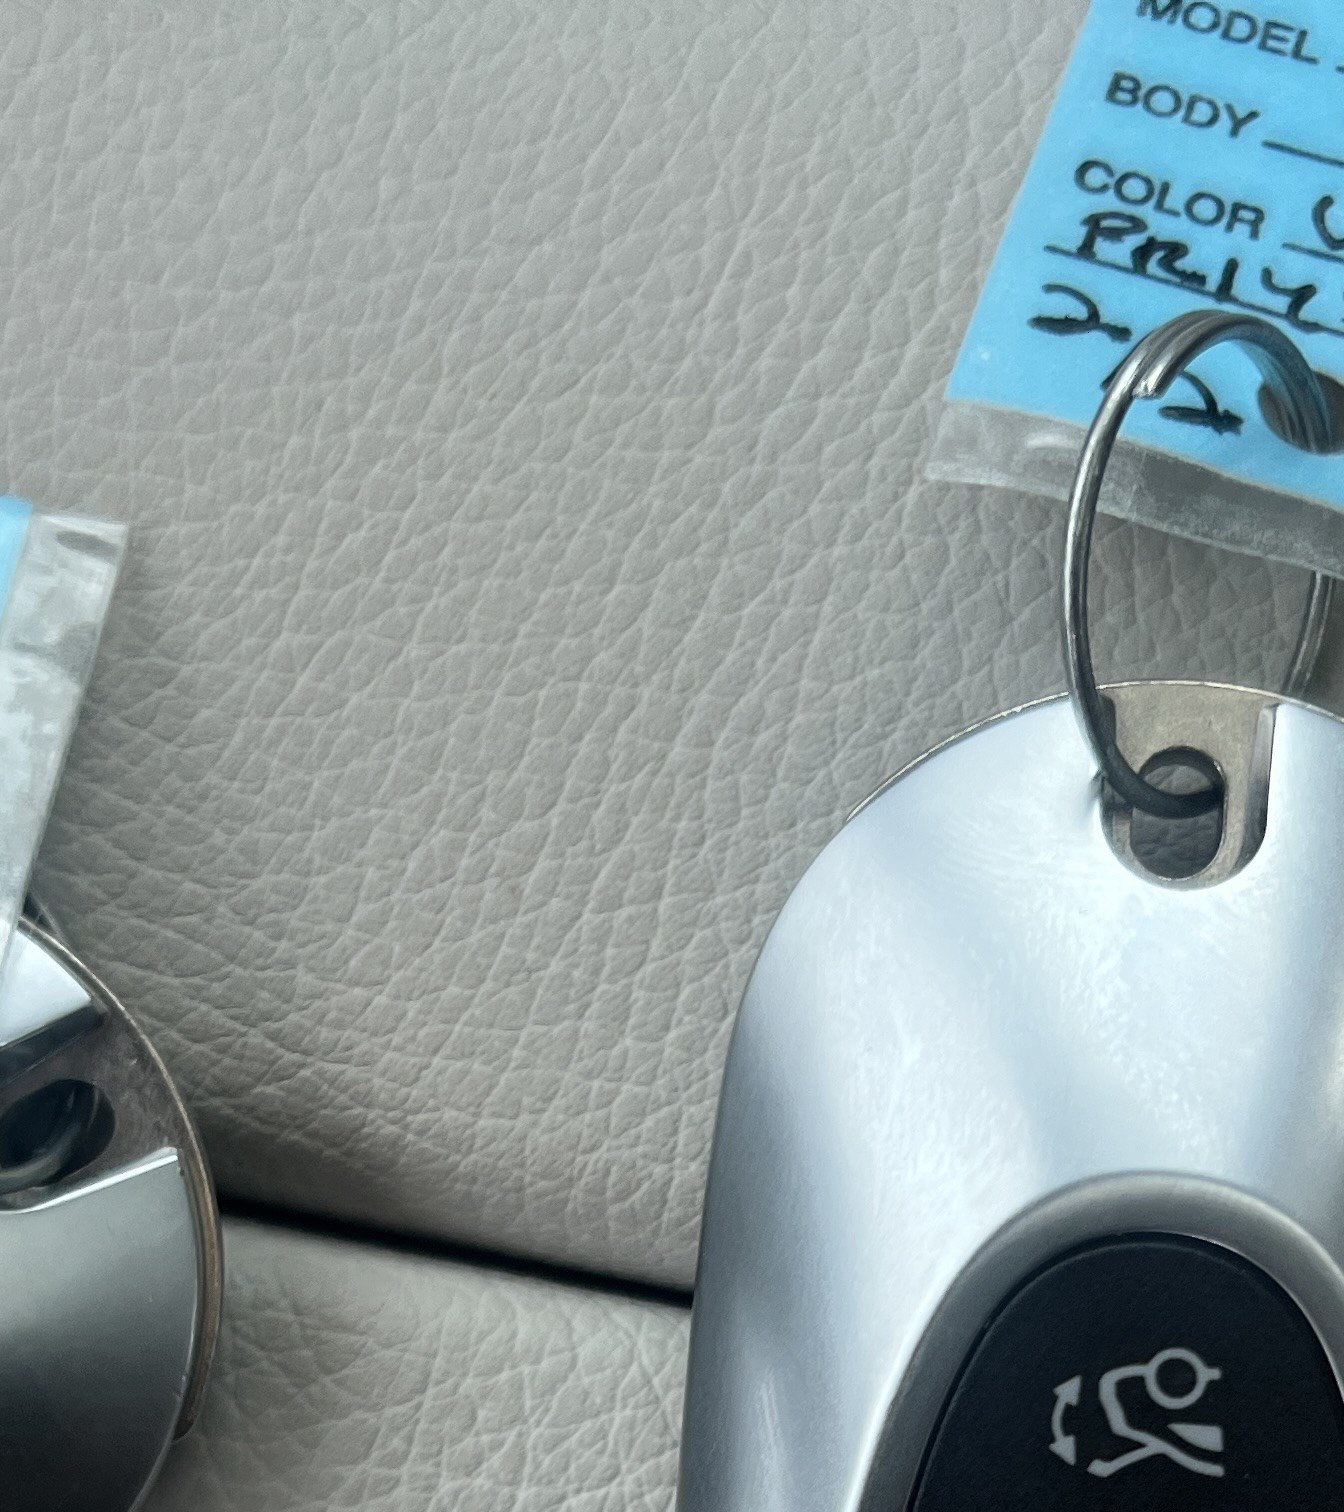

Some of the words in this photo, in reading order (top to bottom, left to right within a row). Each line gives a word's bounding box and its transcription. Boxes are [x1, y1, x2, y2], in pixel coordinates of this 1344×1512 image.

[1136, 0, 1319, 66] MODEL
[1104, 70, 1261, 140] BODY
[1074, 158, 1267, 241] COLOR
